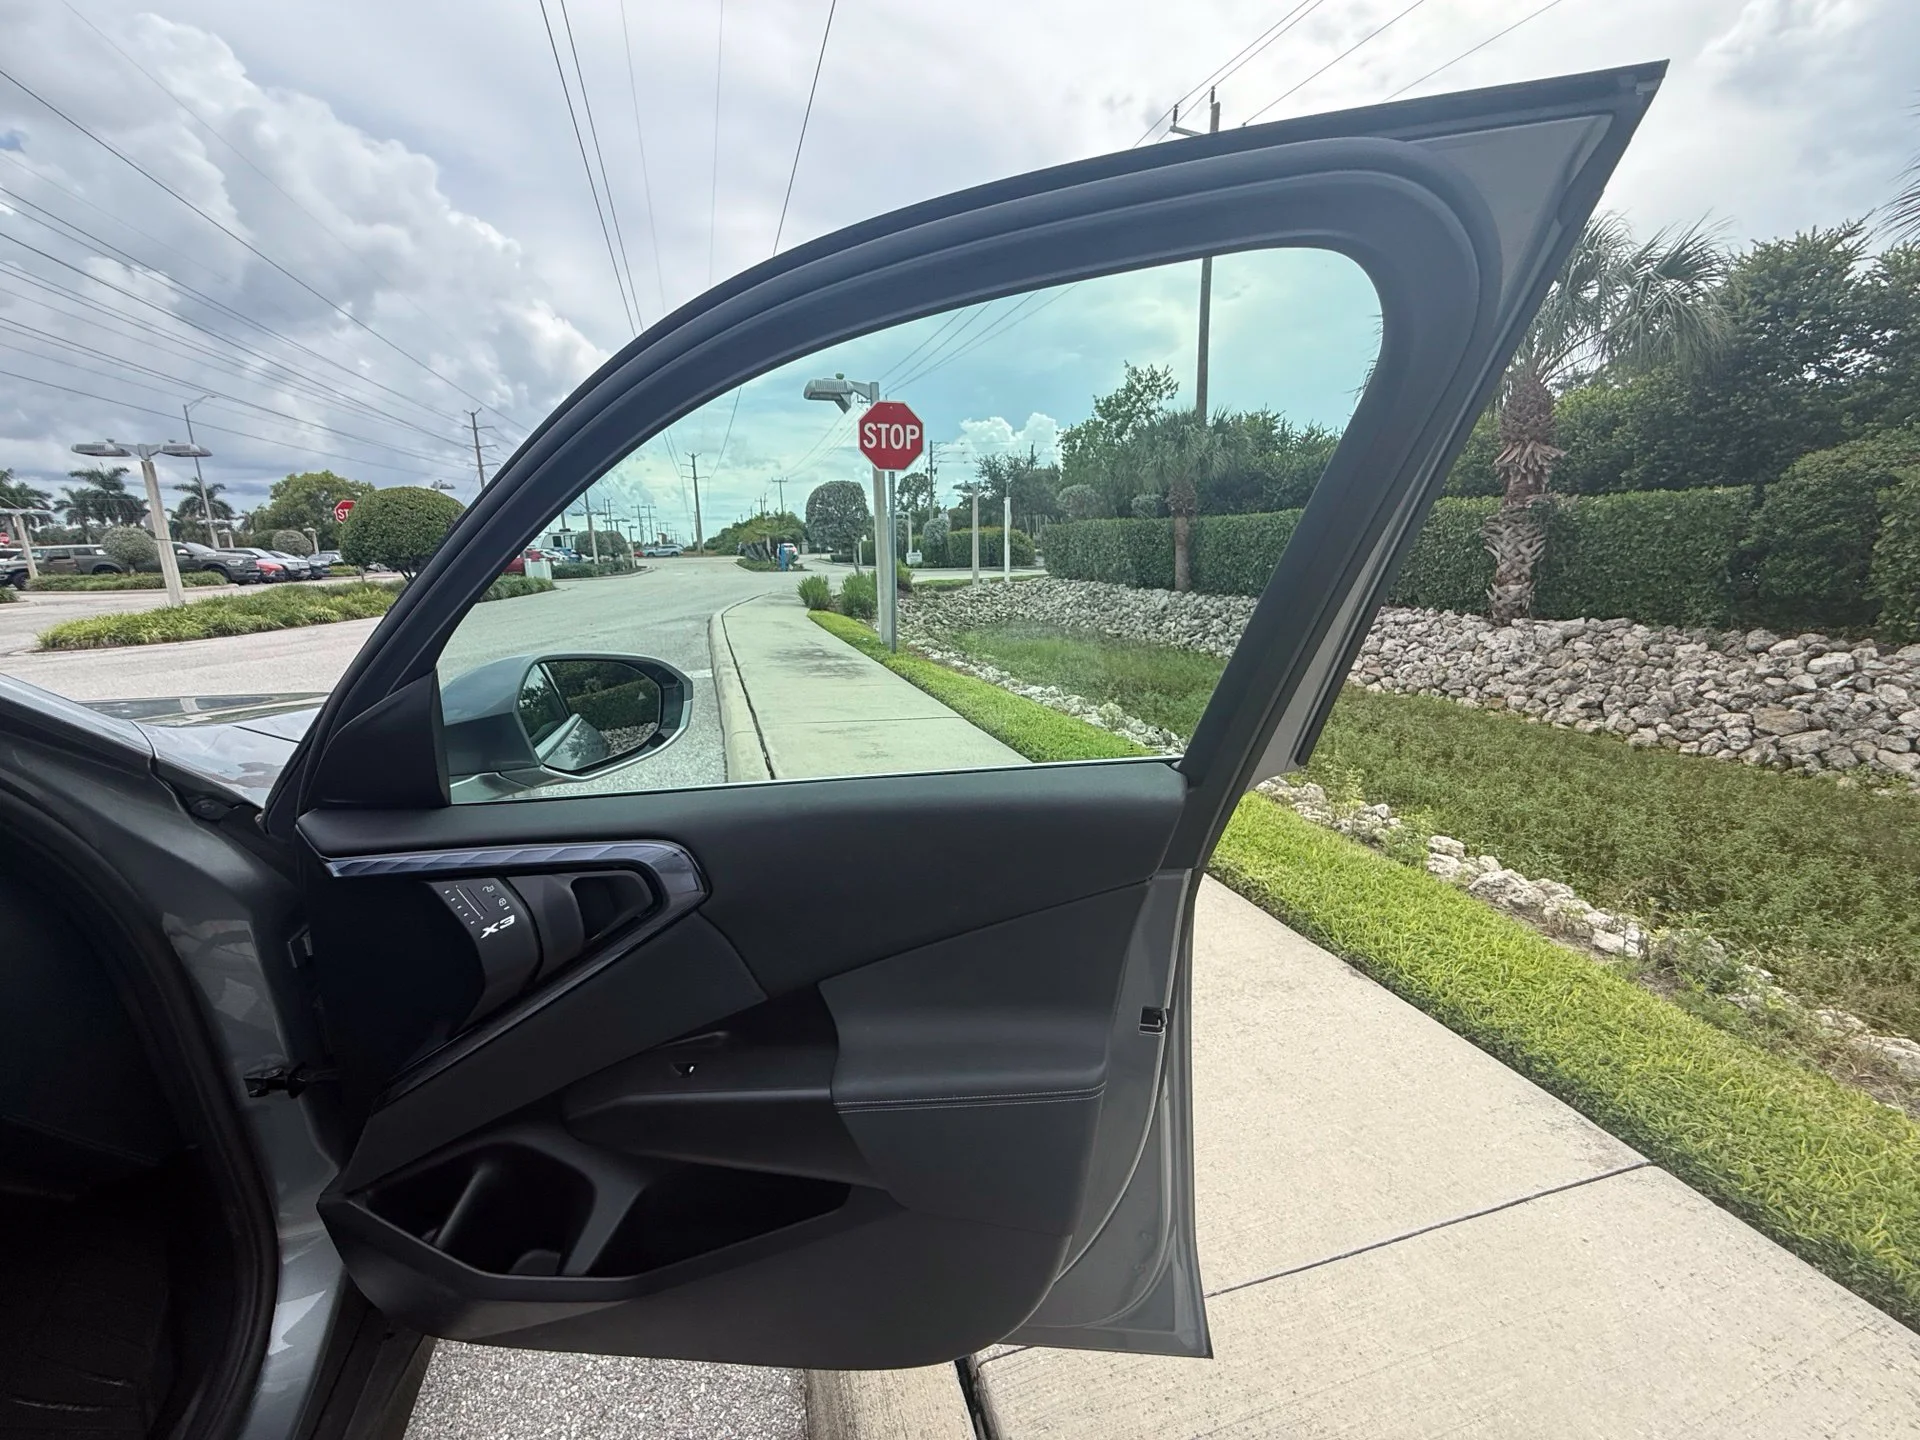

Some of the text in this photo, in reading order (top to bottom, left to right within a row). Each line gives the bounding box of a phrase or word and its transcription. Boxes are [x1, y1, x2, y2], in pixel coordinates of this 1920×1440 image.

[863, 422, 920, 450] STOP
[337, 508, 349, 520] ST
[480, 914, 515, 939] X3
